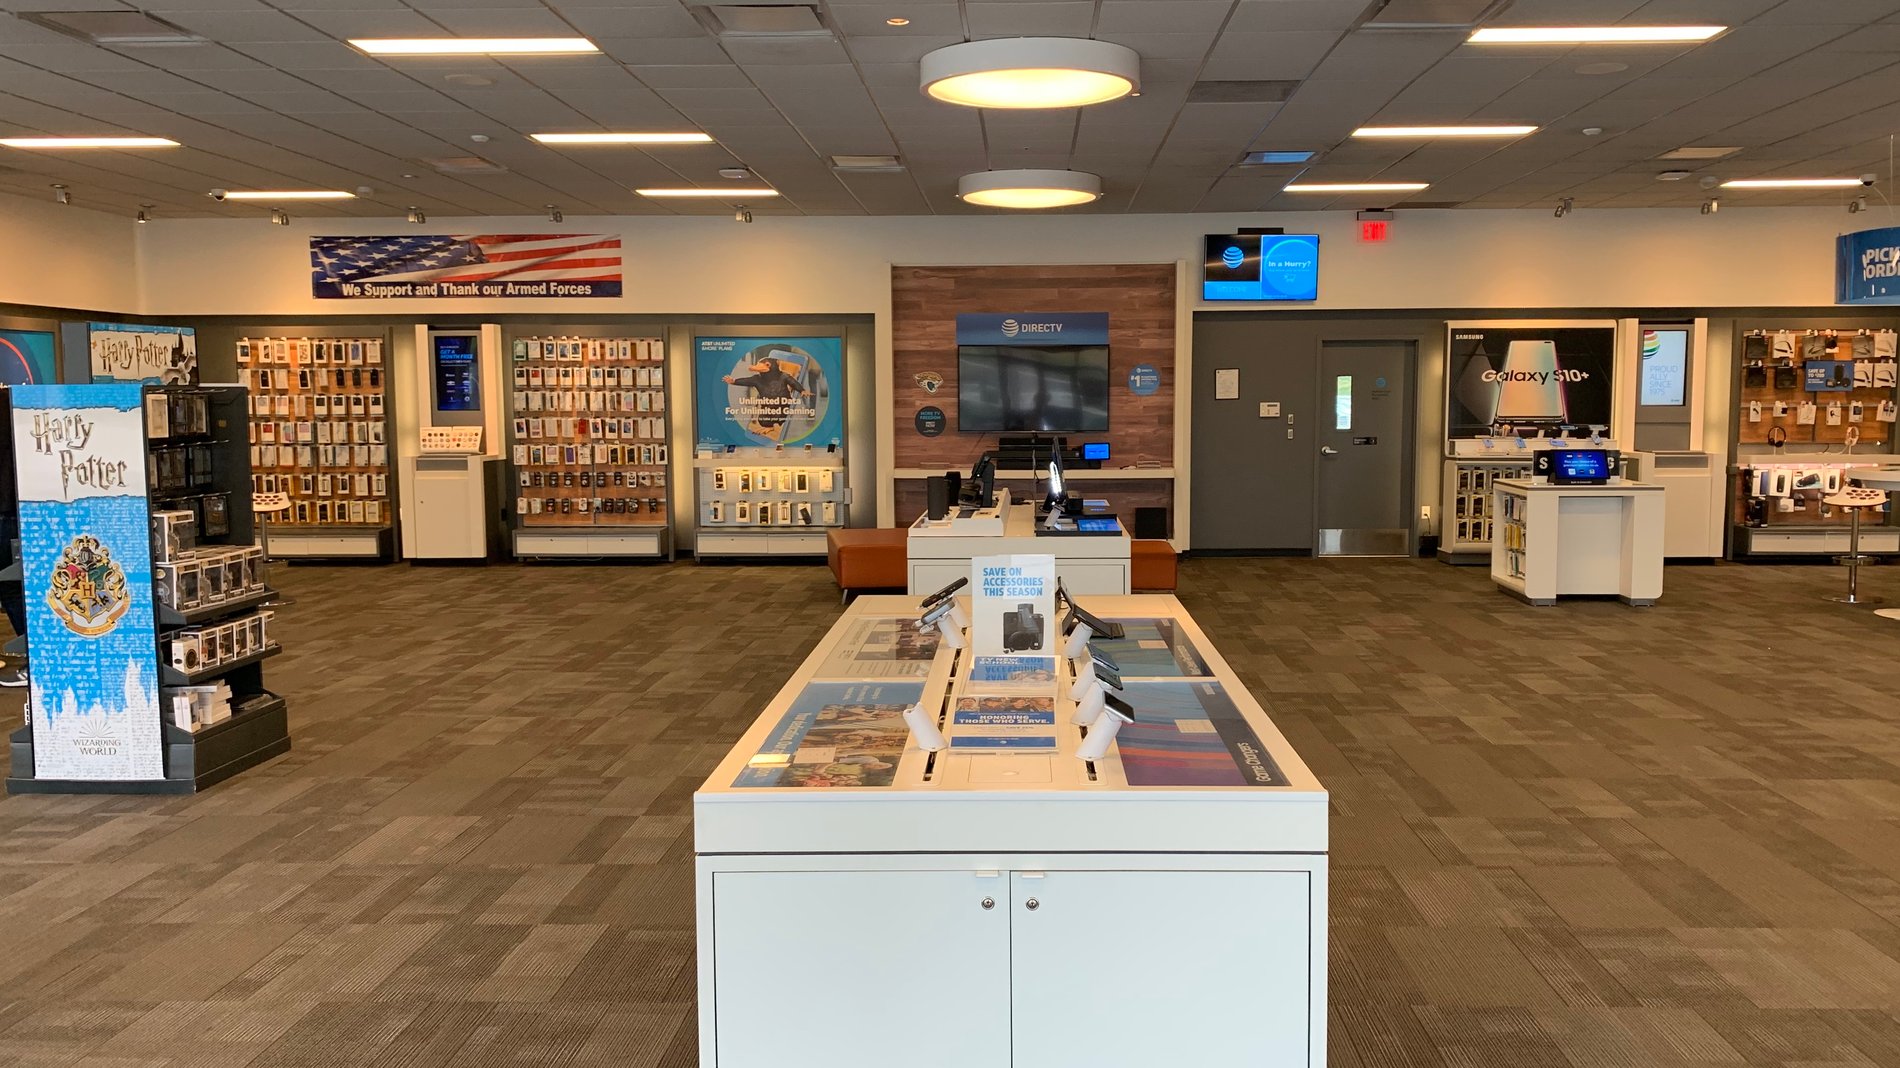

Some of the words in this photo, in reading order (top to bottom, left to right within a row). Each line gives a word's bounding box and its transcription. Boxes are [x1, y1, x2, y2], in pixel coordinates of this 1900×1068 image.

[1284, 260, 1312, 268] Hurry?
[342, 283, 361, 296] We
[363, 283, 412, 298] Support
[415, 283, 437, 296] and
[439, 283, 480, 296] Thank
[483, 285, 503, 296] our
[506, 283, 547, 296] Armed
[549, 283, 592, 296] Forces
[1021, 323, 1063, 333] DIRECTV
[99, 337, 134, 373] Harry
[134, 334, 169, 380] Potter
[1481, 369, 1549, 385] Galaxy
[1553, 369, 1590, 382] S10+
[739, 397, 780, 405] Unlimited
[781, 397, 801, 405] Data
[725, 407, 739, 415] For
[741, 407, 782, 415] Unlimited
[783, 407, 815, 416] Gaming
[30, 412, 94, 455] Harry
[59, 450, 128, 500] Potter
[983, 567, 1006, 577] SAVE
[1009, 567, 1022, 577] ON
[983, 577, 1043, 587] ACCESSORIES
[983, 587, 1004, 596] THIS
[1006, 587, 1043, 596] SEASON
[72, 739, 121, 747] WIZARDING
[79, 746, 117, 756] WORLD
[1237, 742, 1261, 766] Changers
[1252, 764, 1272, 782] Game
